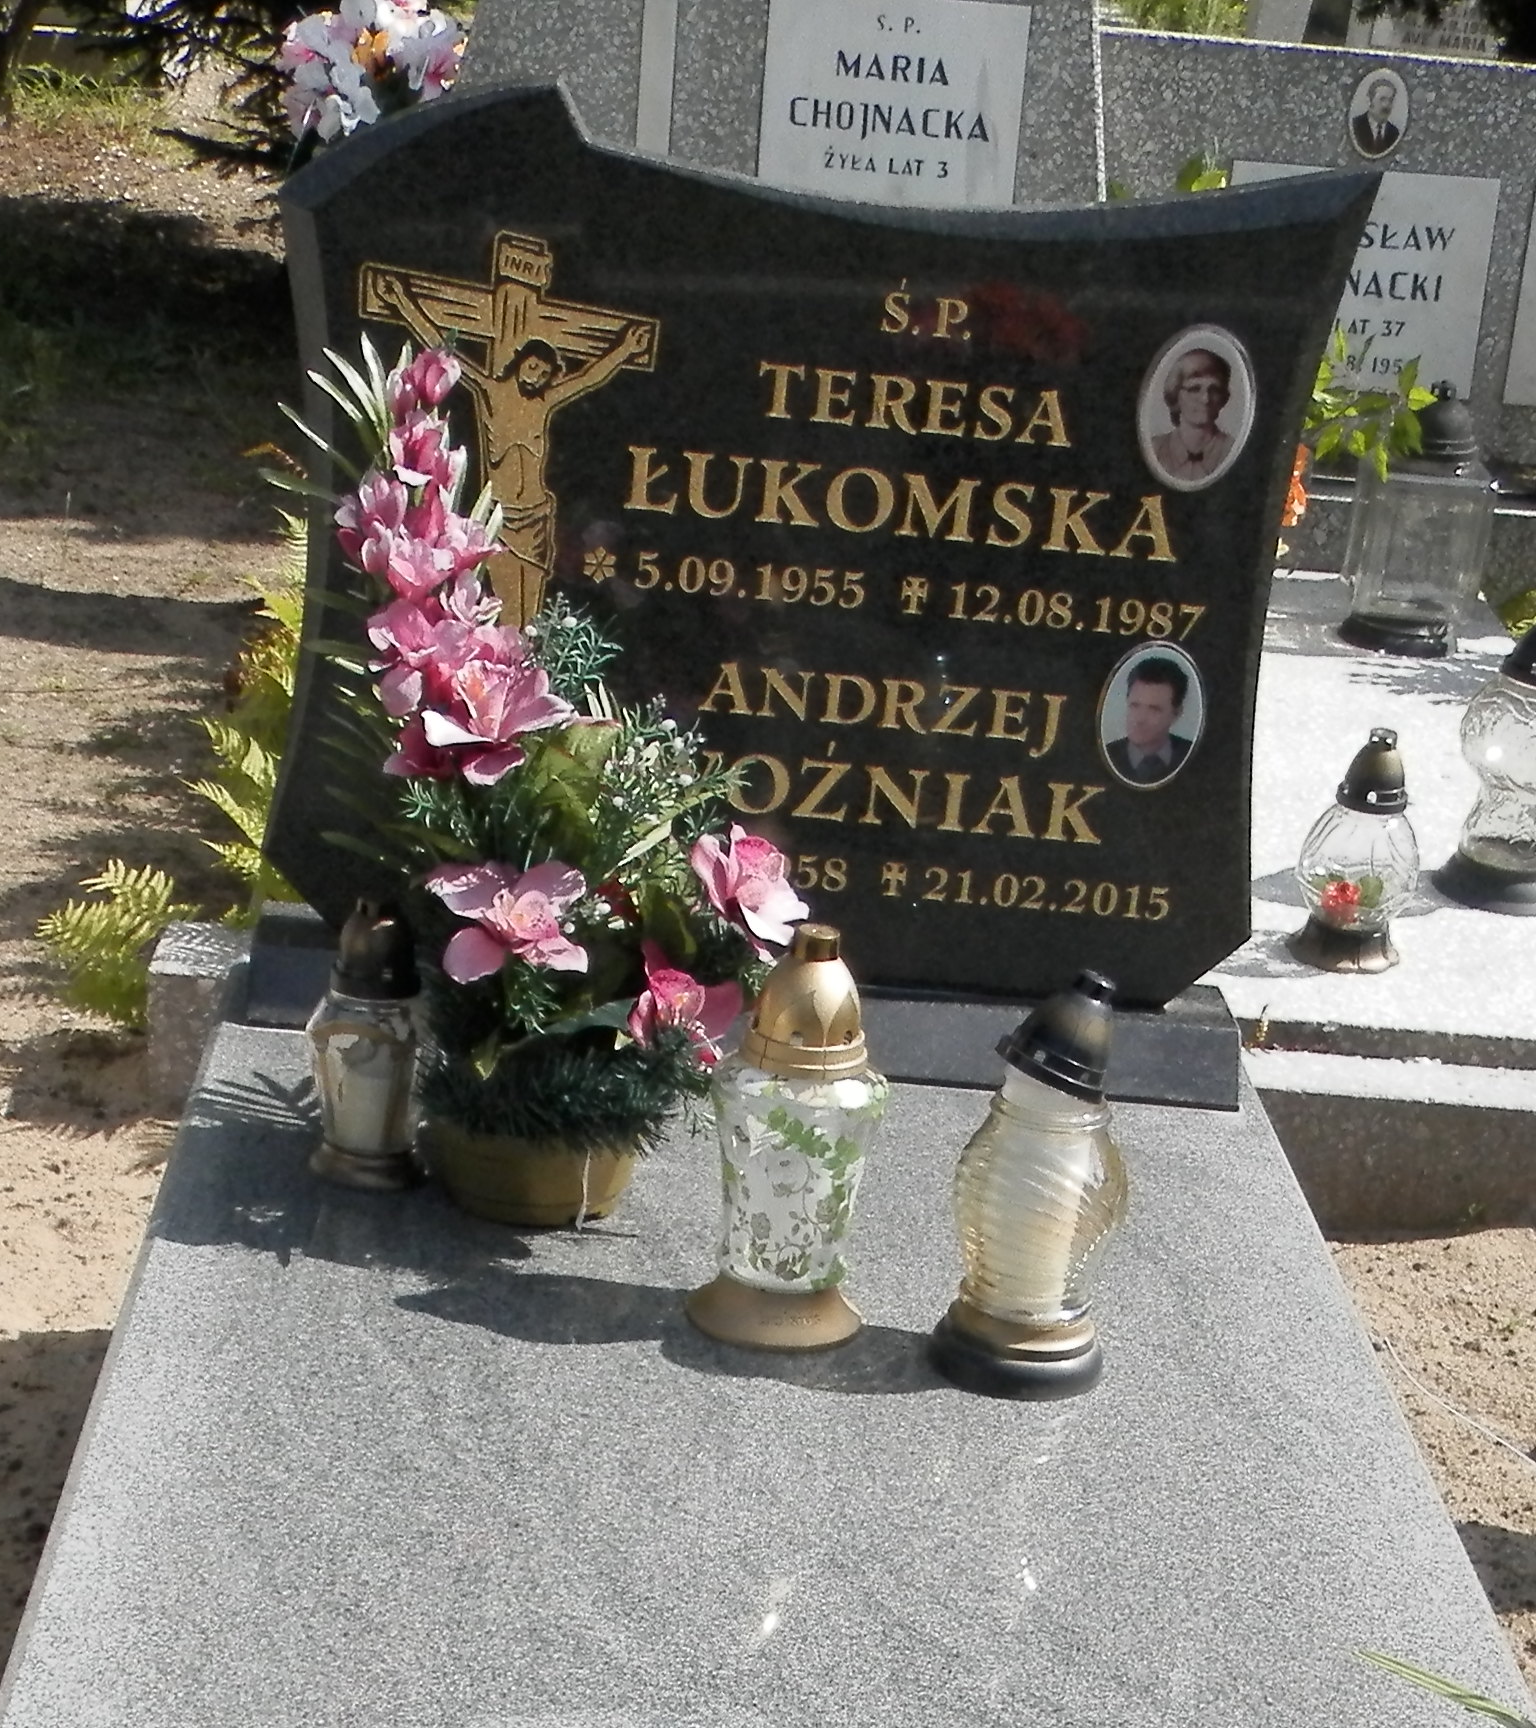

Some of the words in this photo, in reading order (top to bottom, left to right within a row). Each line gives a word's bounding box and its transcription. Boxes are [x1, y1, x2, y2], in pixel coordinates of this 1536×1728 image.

[836, 50, 949, 86] MARIA
[789, 96, 990, 143] CHOJNACKA
[824, 145, 876, 173] ŻYŁA
[888, 157, 924, 177] LAT
[937, 161, 949, 179] 3
[504, 255, 540, 277] INRI
[880, 278, 921, 337] Ś.
[933, 297, 971, 341] P.
[1381, 320, 1406, 337] 37
[1372, 356, 1406, 375] 195
[759, 360, 1072, 448] TERESA
[623, 444, 1177, 563] ŁUKOMSKA
[634, 549, 865, 609] 5.09.1955
[946, 581, 1206, 642] 12.08.1987
[698, 661, 1067, 759] ANDRZEJ
[784, 854, 848, 892] 58
[925, 866, 1170, 921] 21.02.2015
